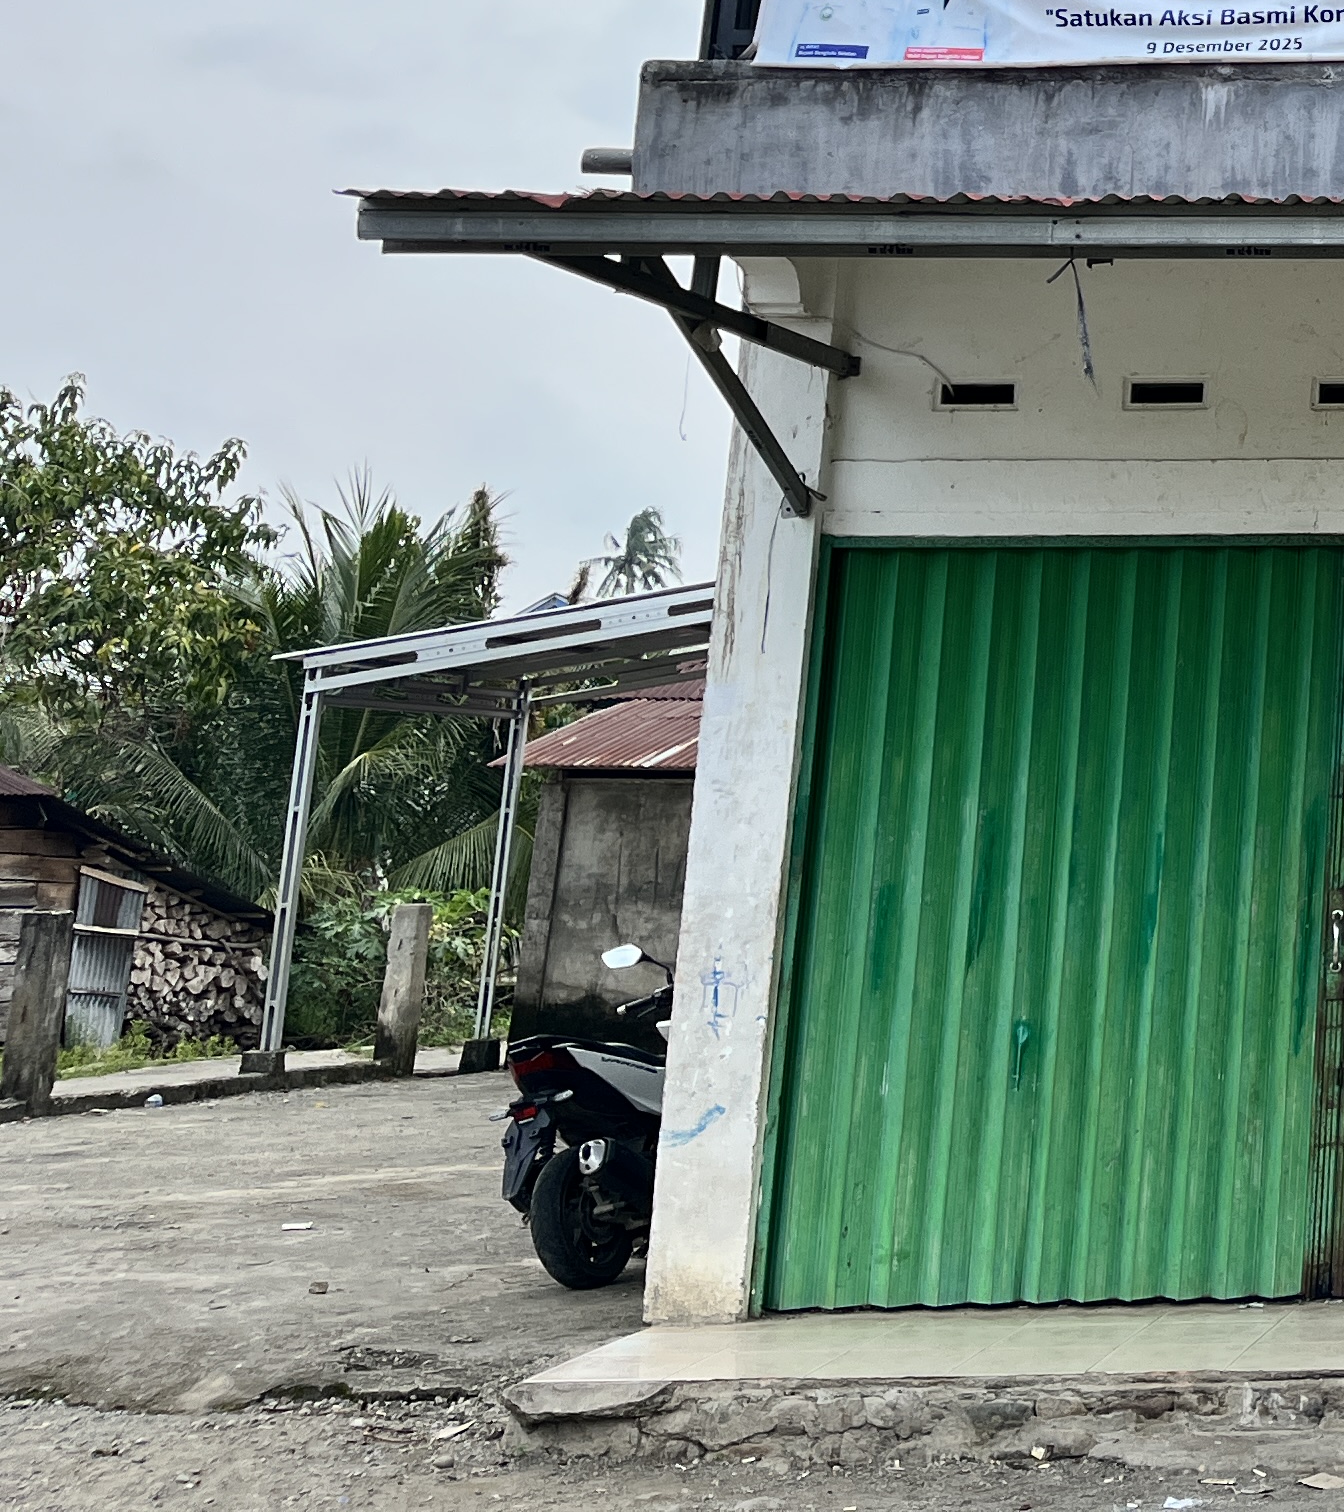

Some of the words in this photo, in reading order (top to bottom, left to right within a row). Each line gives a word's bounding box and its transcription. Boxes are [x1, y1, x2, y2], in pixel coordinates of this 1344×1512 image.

[1045, 8, 1153, 28] "Satukan
[1159, 8, 1212, 27] Aksi
[1220, 6, 1296, 26] Basmi
[1145, 41, 1158, 55] 9
[1163, 39, 1253, 55] Desember
[1258, 36, 1304, 52] 2025
